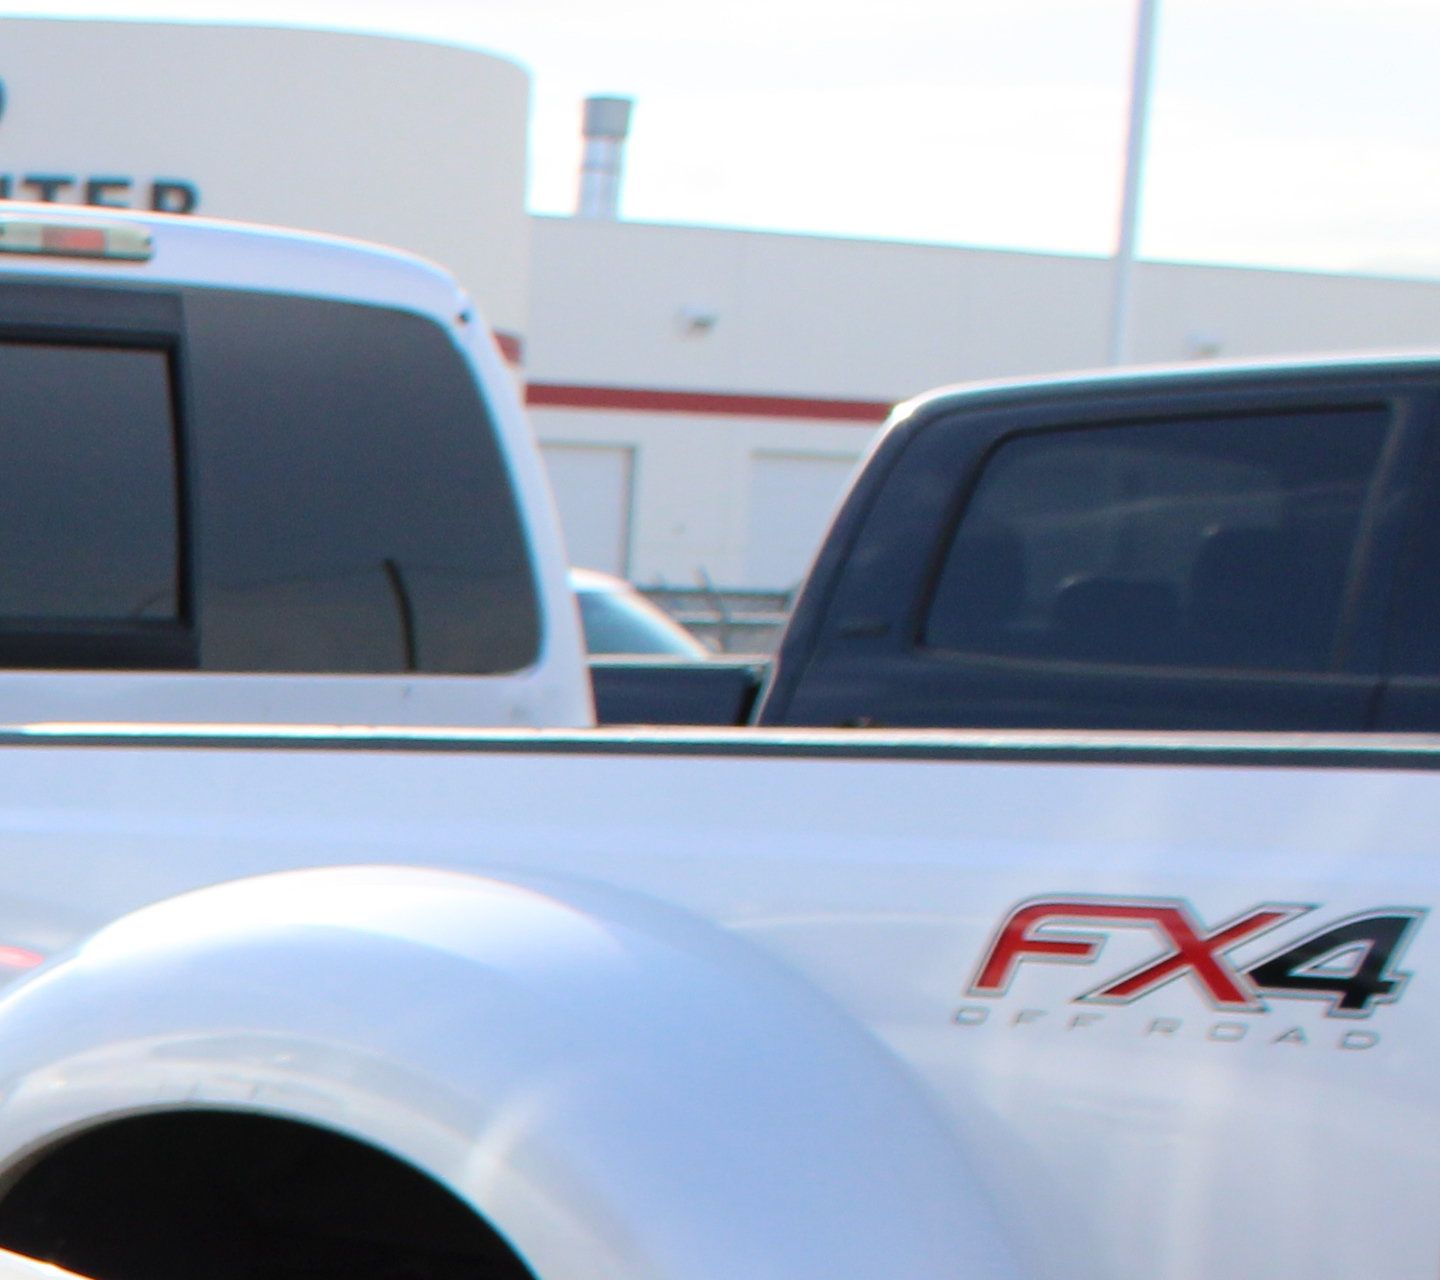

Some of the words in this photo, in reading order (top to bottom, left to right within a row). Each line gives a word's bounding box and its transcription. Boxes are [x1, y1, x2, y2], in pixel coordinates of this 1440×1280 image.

[966, 893, 1430, 1019] FX4
[952, 1006, 1104, 1029] OFF
[1147, 1018, 1382, 1050] ROAD
